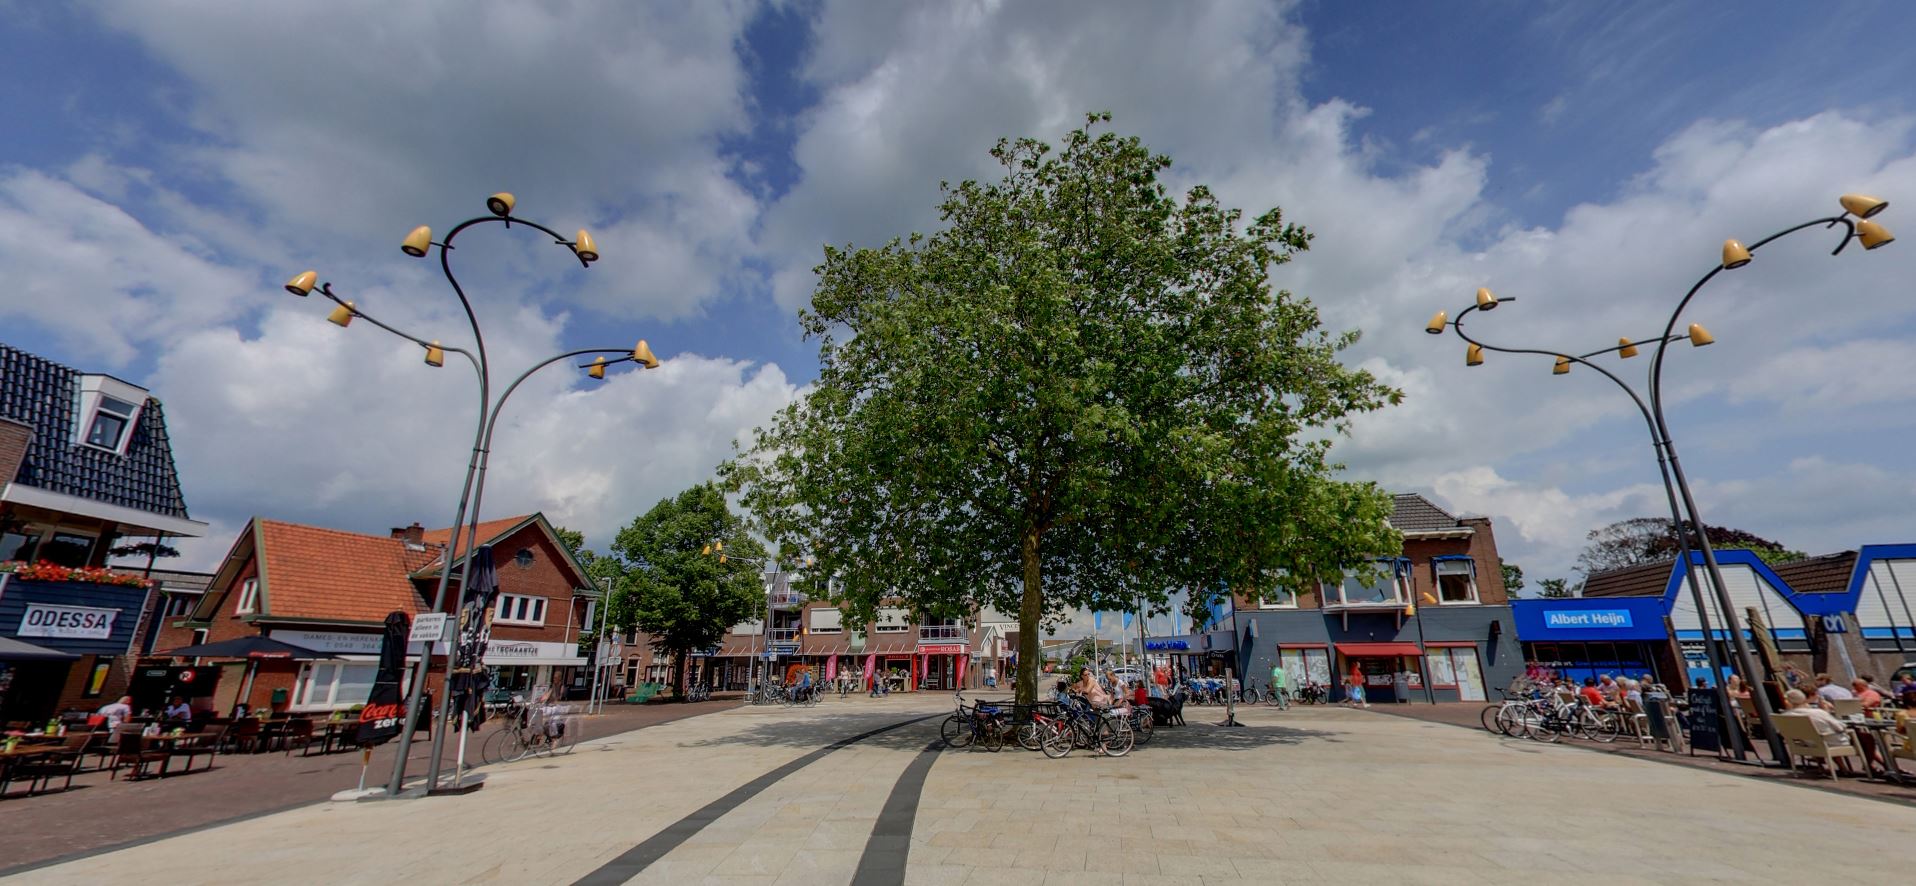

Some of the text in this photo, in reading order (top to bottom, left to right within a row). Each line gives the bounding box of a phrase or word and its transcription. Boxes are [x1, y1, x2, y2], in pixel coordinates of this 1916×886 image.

[28, 609, 108, 629] ODESSA
[1550, 612, 1625, 626] Albert Heijn
